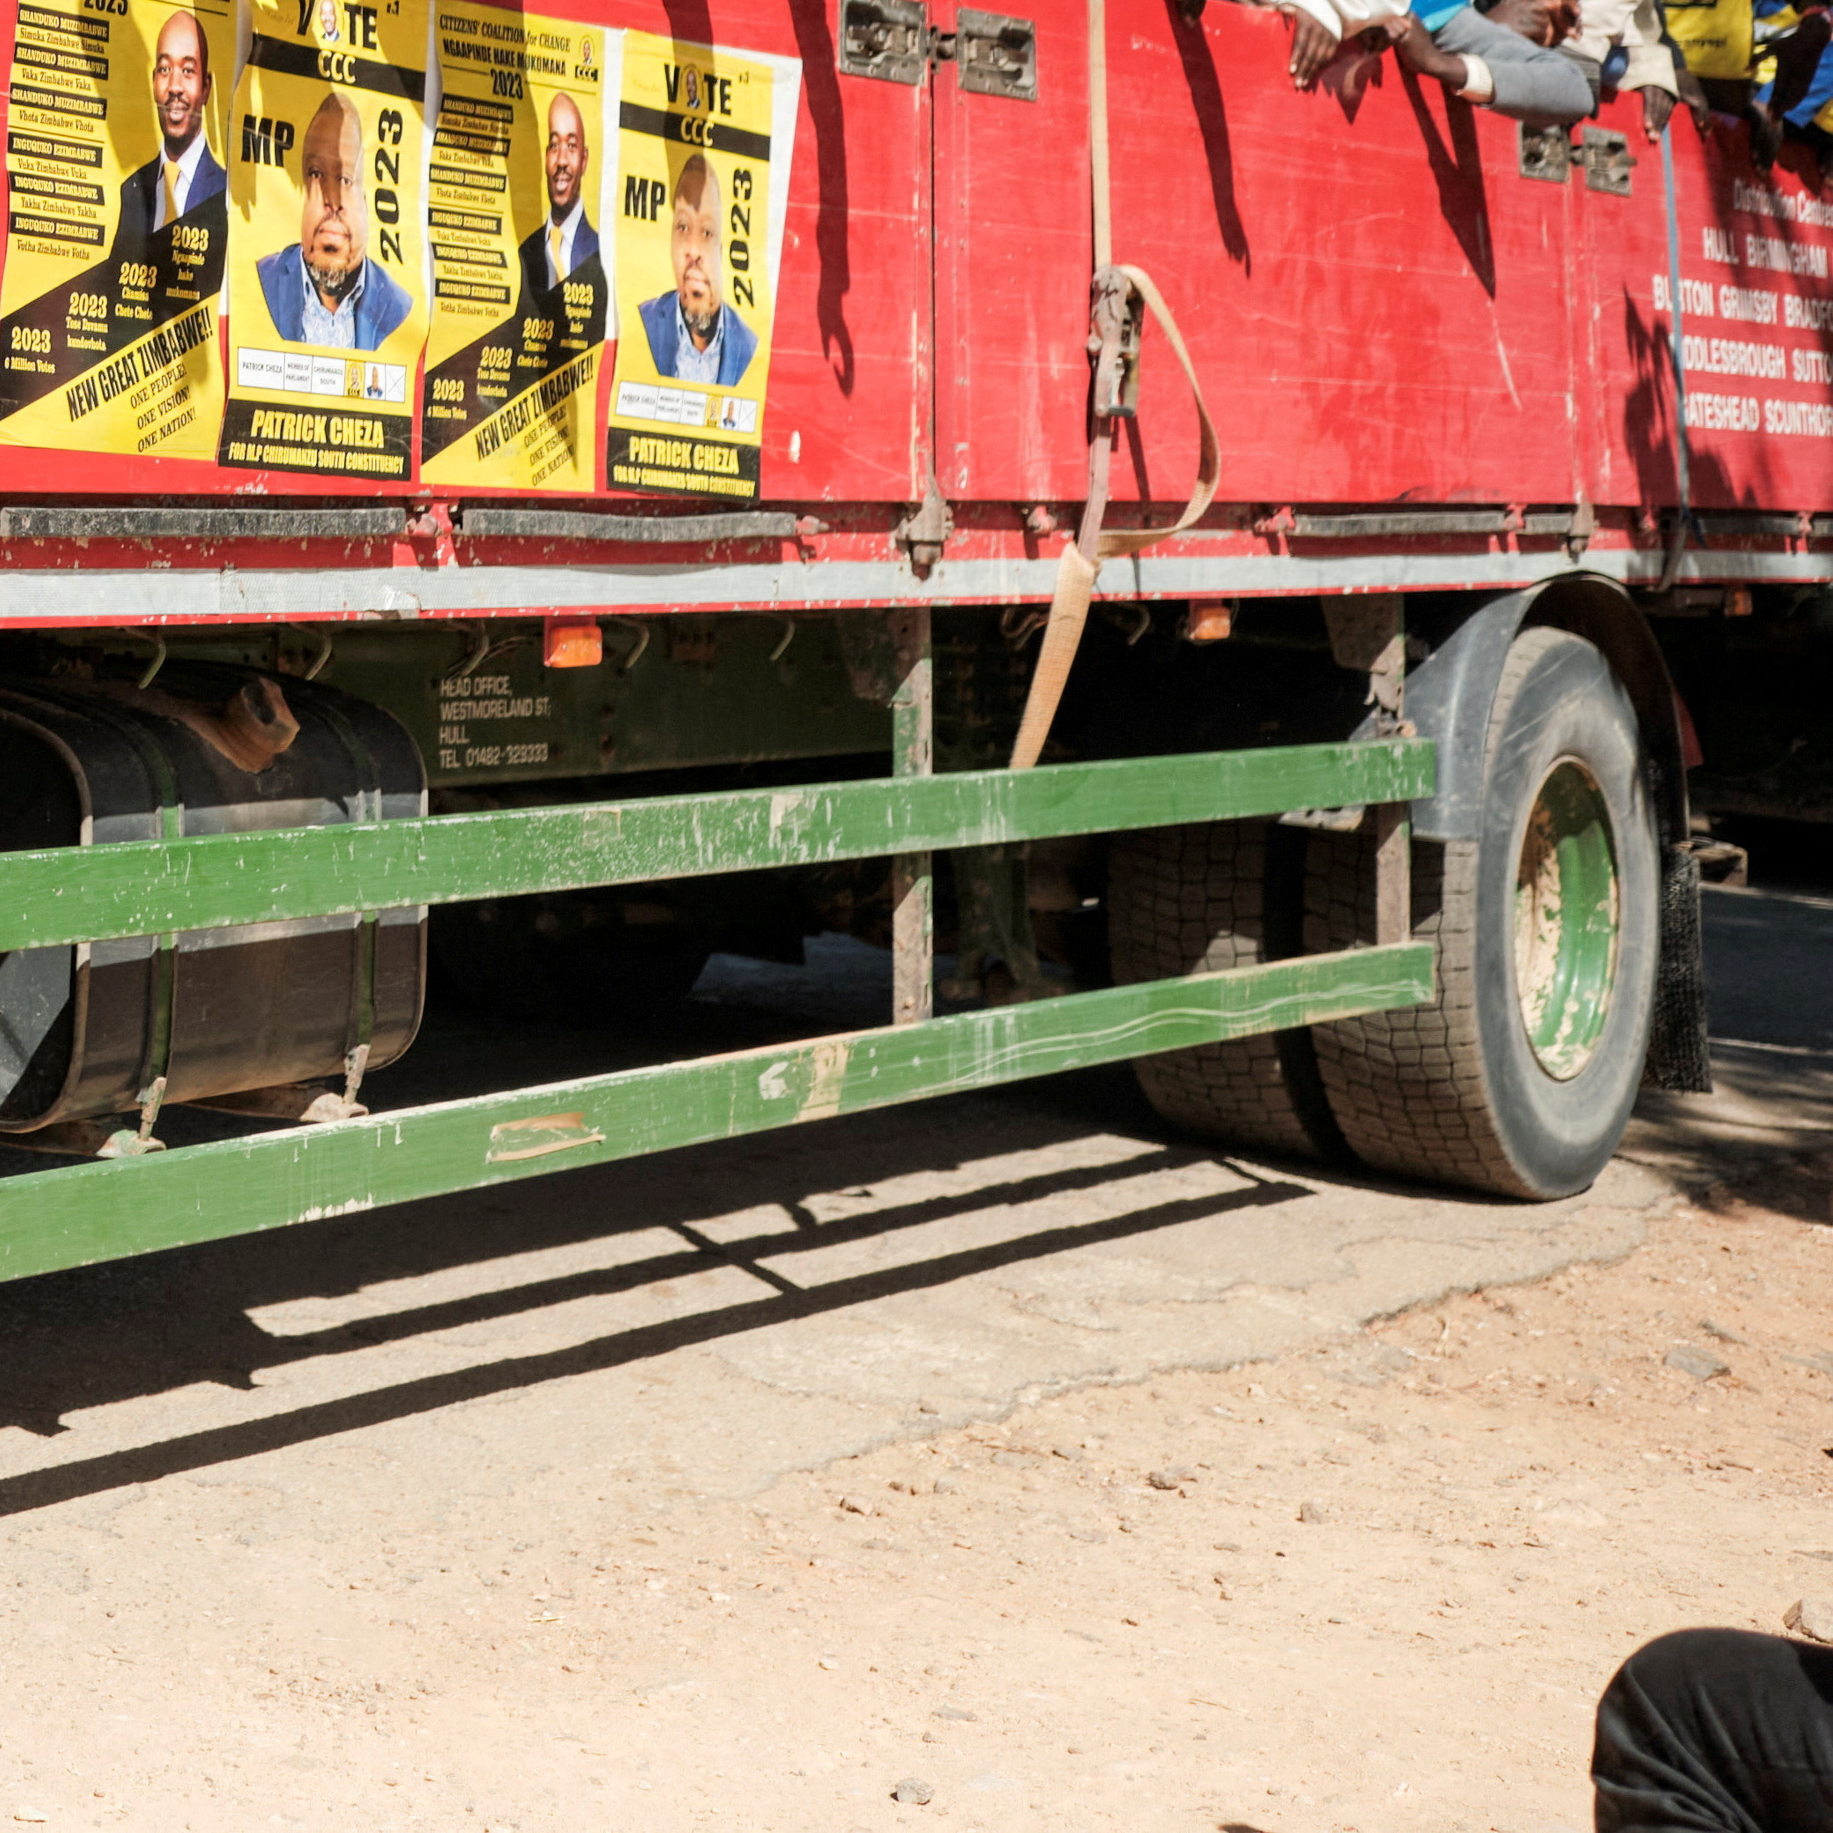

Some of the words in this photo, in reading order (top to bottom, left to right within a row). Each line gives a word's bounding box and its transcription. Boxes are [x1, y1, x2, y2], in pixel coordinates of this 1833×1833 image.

[20, 10, 59, 28] SHANDUKO
[20, 27, 45, 41] Simuka
[47, 33, 79, 49] Zimbabwe
[482, 22, 525, 44] COALITION
[539, 34, 571, 52] CHANGE
[317, 50, 356, 84] CCC
[493, 48, 515, 67] HAKE
[577, 69, 595, 79] CCC
[490, 69, 524, 99] 2023
[664, 63, 732, 116] VTE
[241, 114, 295, 168] MP
[680, 116, 715, 147] CCC
[374, 107, 404, 266] 2023
[624, 174, 666, 223] MP
[172, 225, 209, 251] 2023
[729, 166, 754, 309] 2023
[1703, 226, 1739, 265] HULL
[1746, 234, 1828, 279] BIRMINGHAM
[119, 261, 157, 288] 2023
[68, 292, 107, 318] 2023
[1719, 283, 1778, 325] GRIMSBY
[11, 326, 51, 353] 2023
[1669, 332, 1786, 380] DDLESBROUGH
[11, 357, 35, 372] Million
[37, 359, 56, 374] Votes
[66, 376, 100, 423] NEW
[99, 353, 140, 400] GREAT
[137, 305, 214, 378] ZIMBABWE!!
[130, 392, 150, 410] ONE
[151, 363, 187, 399] PEOPLE!
[137, 413, 157, 430] ONE
[158, 385, 191, 420] VISION!
[138, 434, 158, 453] ONE
[159, 407, 196, 442] NATION!
[251, 409, 328, 444] PATRICK
[330, 417, 385, 449] CHEZA
[475, 425, 500, 462] NEW
[500, 396, 534, 443] GREAT
[228, 442, 246, 461] FOR
[263, 445, 318, 467] CHIRUMANZU
[318, 450, 346, 469] SOUTH
[346, 452, 404, 475] CONSTITUENCY
[629, 435, 692, 468] PATRICK
[693, 444, 740, 475] CHEZA
[440, 678, 471, 697] HEAD
[439, 698, 533, 722] WESTMORELAND
[439, 726, 469, 745] HULL
[440, 750, 461, 769] TEL
